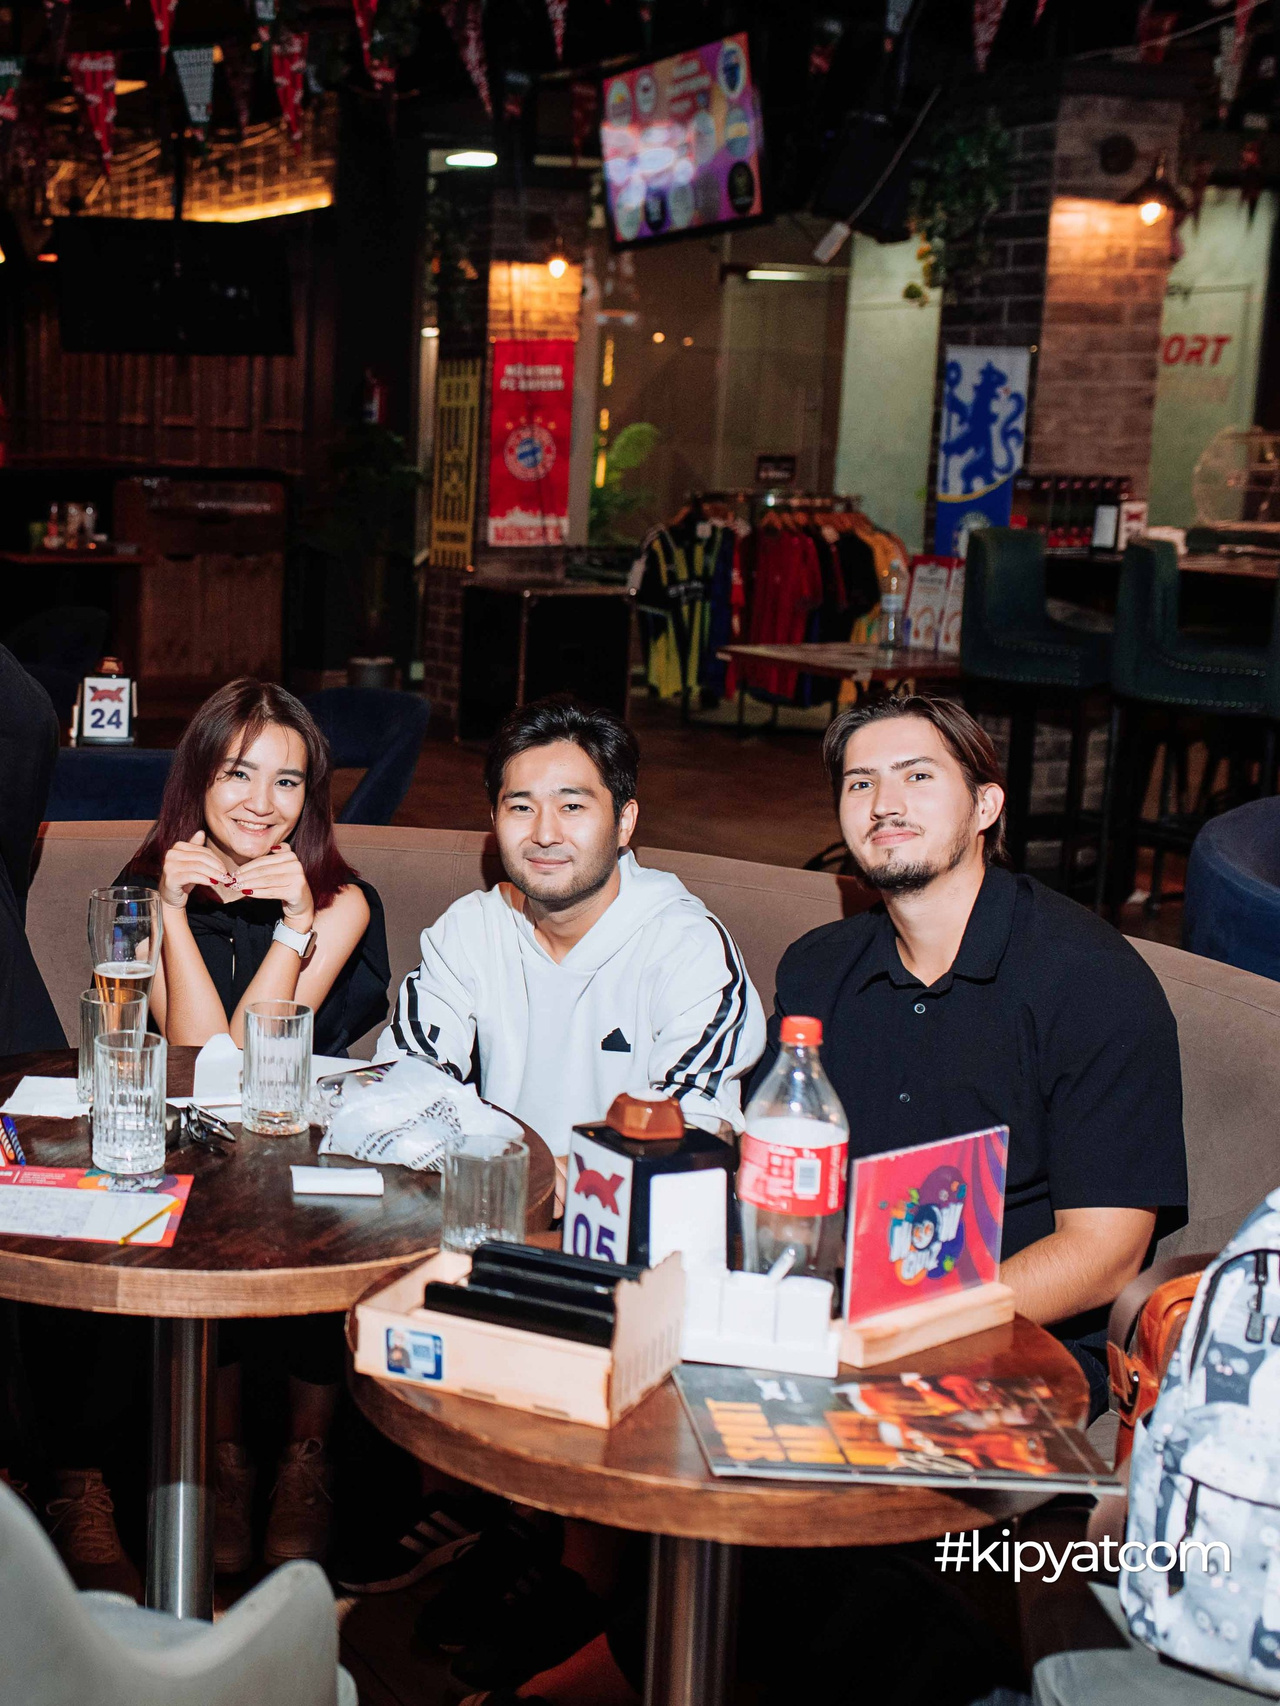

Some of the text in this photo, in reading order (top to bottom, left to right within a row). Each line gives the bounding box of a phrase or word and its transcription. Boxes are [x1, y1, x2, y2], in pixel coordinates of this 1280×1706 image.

[1161, 333, 1232, 366] ORT
[90, 708, 123, 729] 24
[572, 1213, 616, 1263] 05
